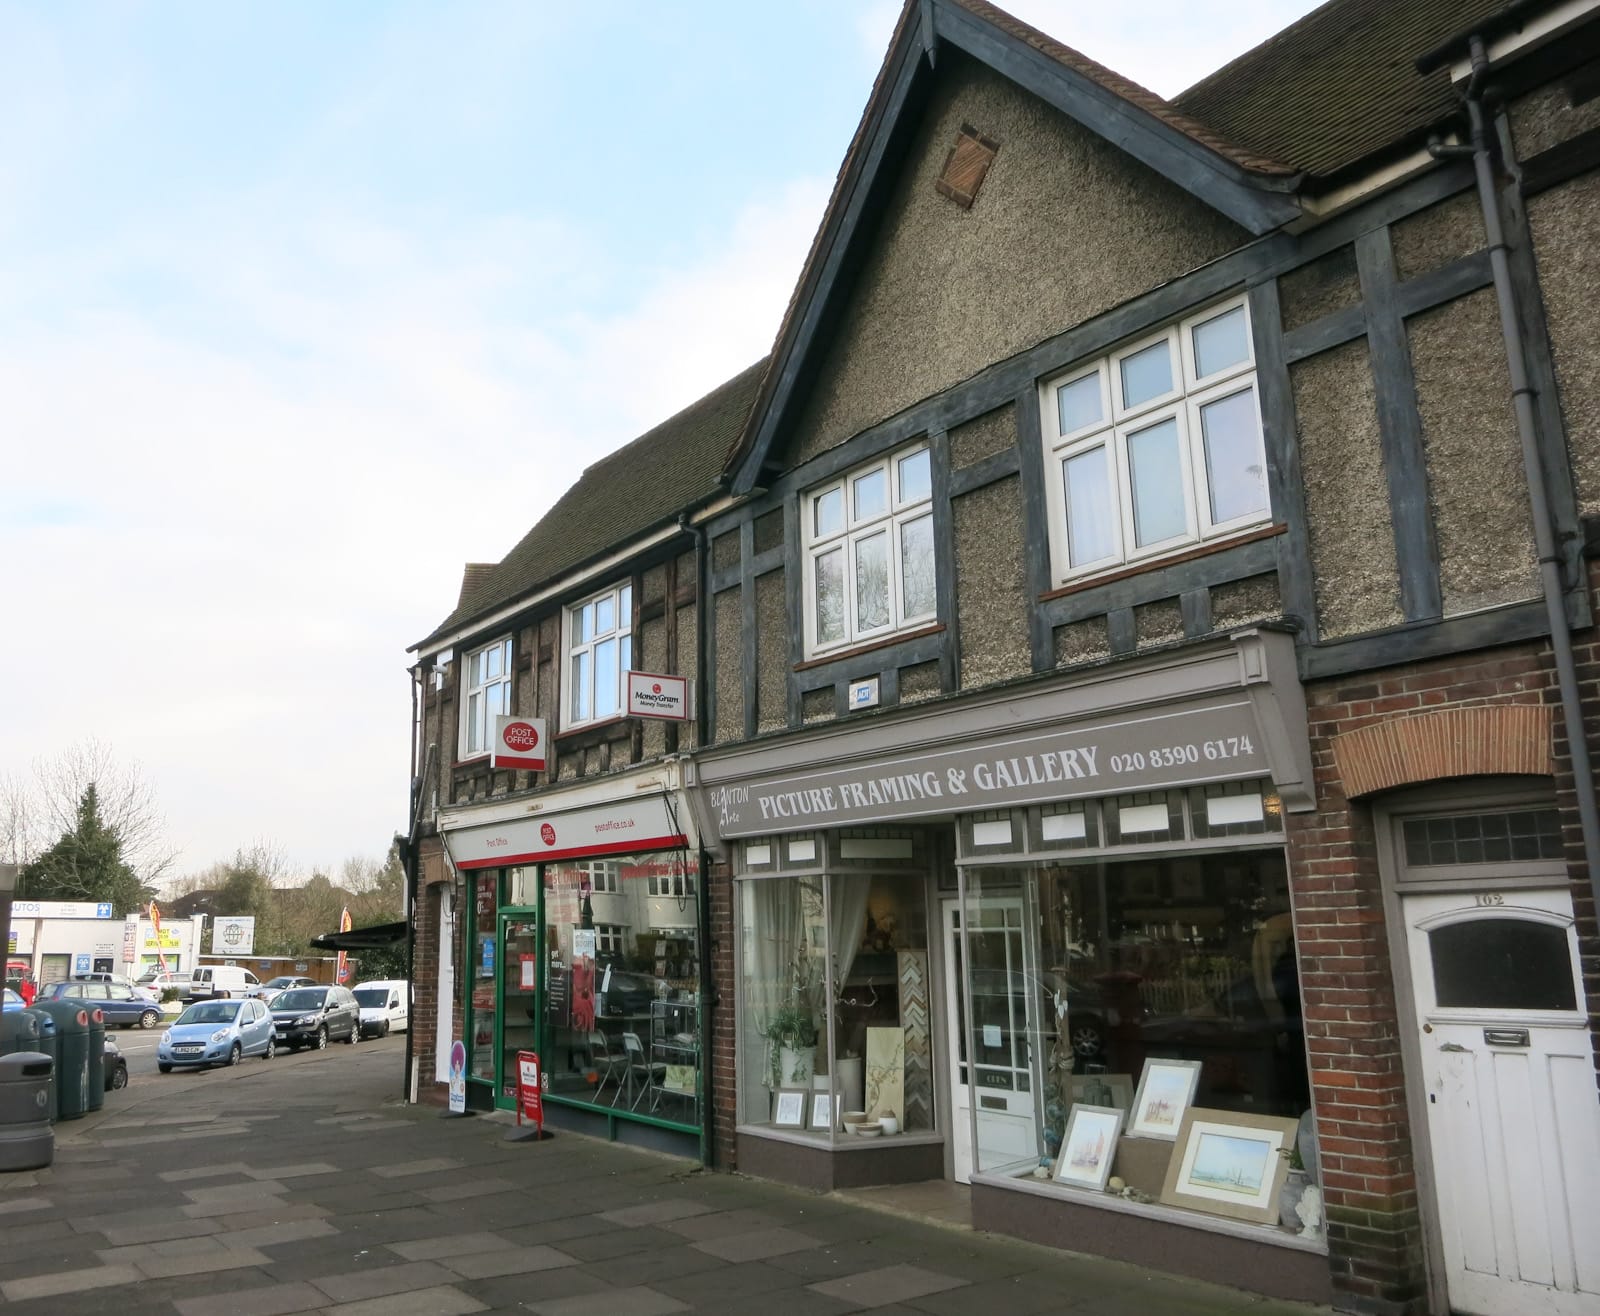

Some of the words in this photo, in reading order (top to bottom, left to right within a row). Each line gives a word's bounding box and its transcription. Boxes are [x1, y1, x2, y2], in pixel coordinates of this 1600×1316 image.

[635, 691, 680, 703] MoneyGram
[857, 688, 869, 700] ADT
[639, 700, 655, 708] Money
[511, 728, 532, 737] POST
[506, 735, 535, 746] OFFICE
[759, 787, 838, 820] PICTURE
[838, 771, 943, 809] FRAMING
[946, 767, 968, 795] &
[972, 745, 1100, 791] GALLERY
[1110, 752, 1145, 774] 020
[1149, 744, 1199, 769] 8390
[1203, 735, 1254, 760] 6174
[486, 838, 495, 847] Post
[495, 837, 508, 847] Office
[594, 818, 635, 833] postoffice.co.uk
